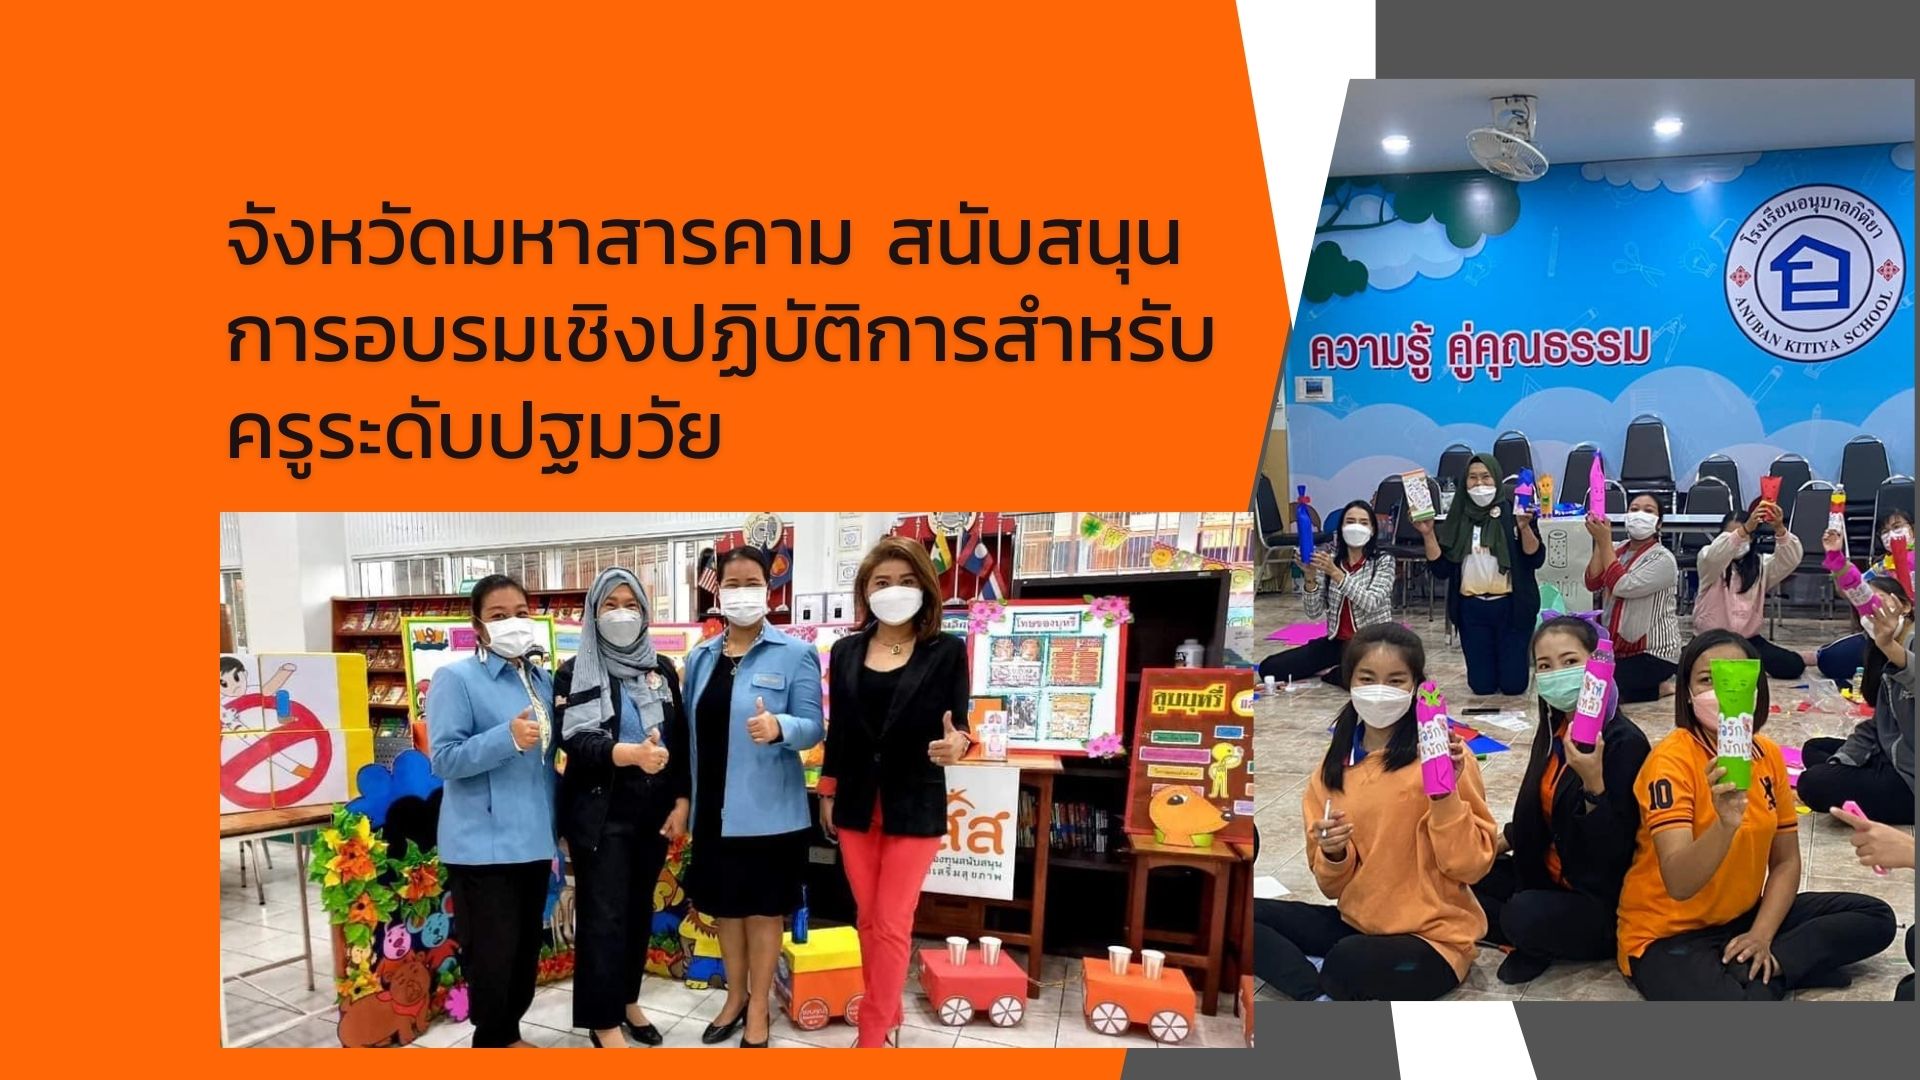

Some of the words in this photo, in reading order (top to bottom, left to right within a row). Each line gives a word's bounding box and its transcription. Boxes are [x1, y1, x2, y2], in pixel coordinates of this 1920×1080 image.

[1740, 195, 1884, 246] โรงเรียนอนุบาลกิติยา
[1735, 296, 1782, 347] ANUBAN
[1785, 338, 1841, 355] KITIYA
[1843, 290, 1893, 345] SCHOOL
[1311, 323, 1431, 381] ความรู้
[1448, 322, 1650, 380] คู่คุณธรรม
[1647, 778, 1674, 811] 10
